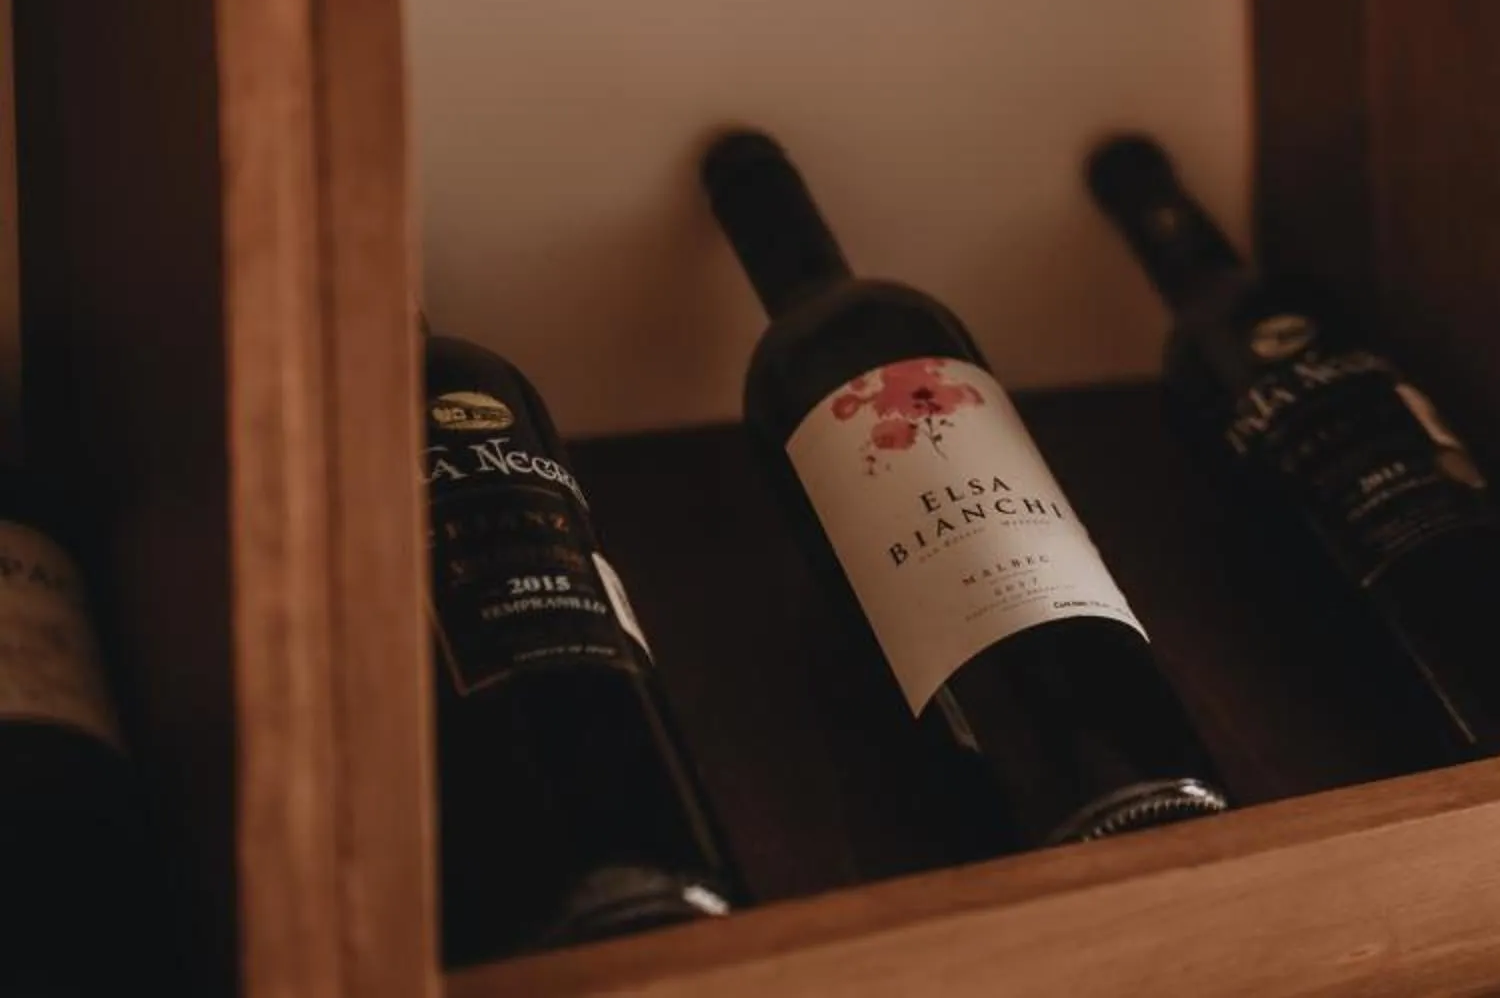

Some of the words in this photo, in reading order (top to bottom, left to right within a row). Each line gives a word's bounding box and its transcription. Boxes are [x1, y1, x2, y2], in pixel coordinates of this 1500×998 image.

[919, 475, 1011, 513] ELSA
[888, 498, 1063, 567] BIANCHI
[507, 575, 571, 595] 2015
